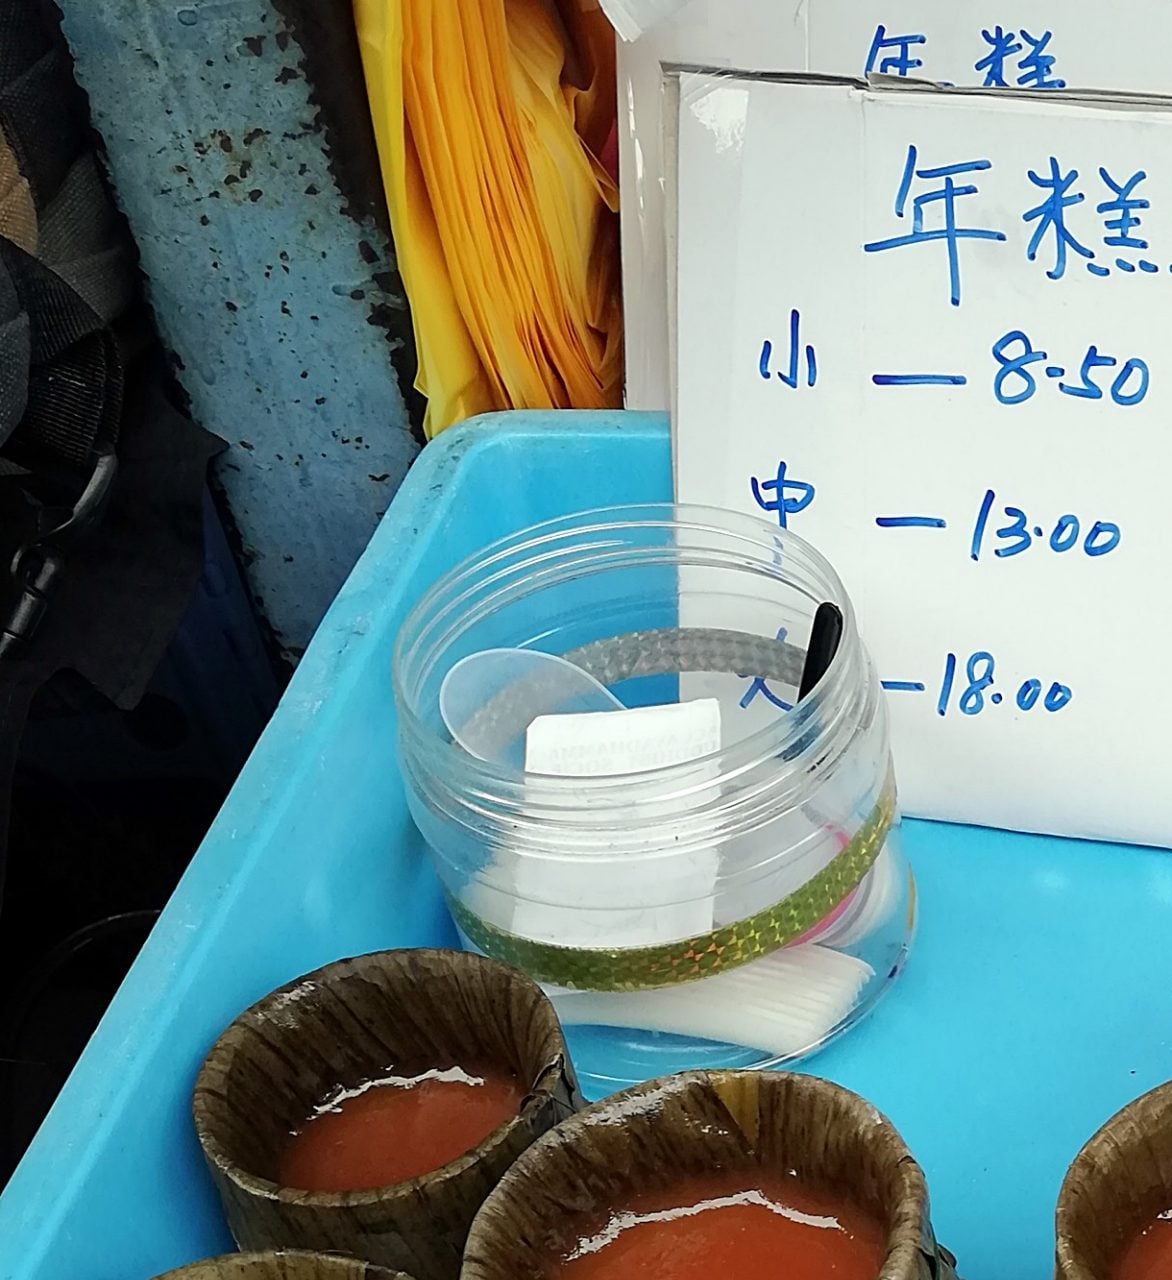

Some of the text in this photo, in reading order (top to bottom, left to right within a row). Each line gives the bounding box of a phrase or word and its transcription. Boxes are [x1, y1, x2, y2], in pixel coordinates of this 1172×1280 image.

[759, 309, 816, 388] 小
[750, 461, 815, 570] 中
[970, 489, 1120, 560] 13.00
[937, 651, 1072, 716] 18.00
